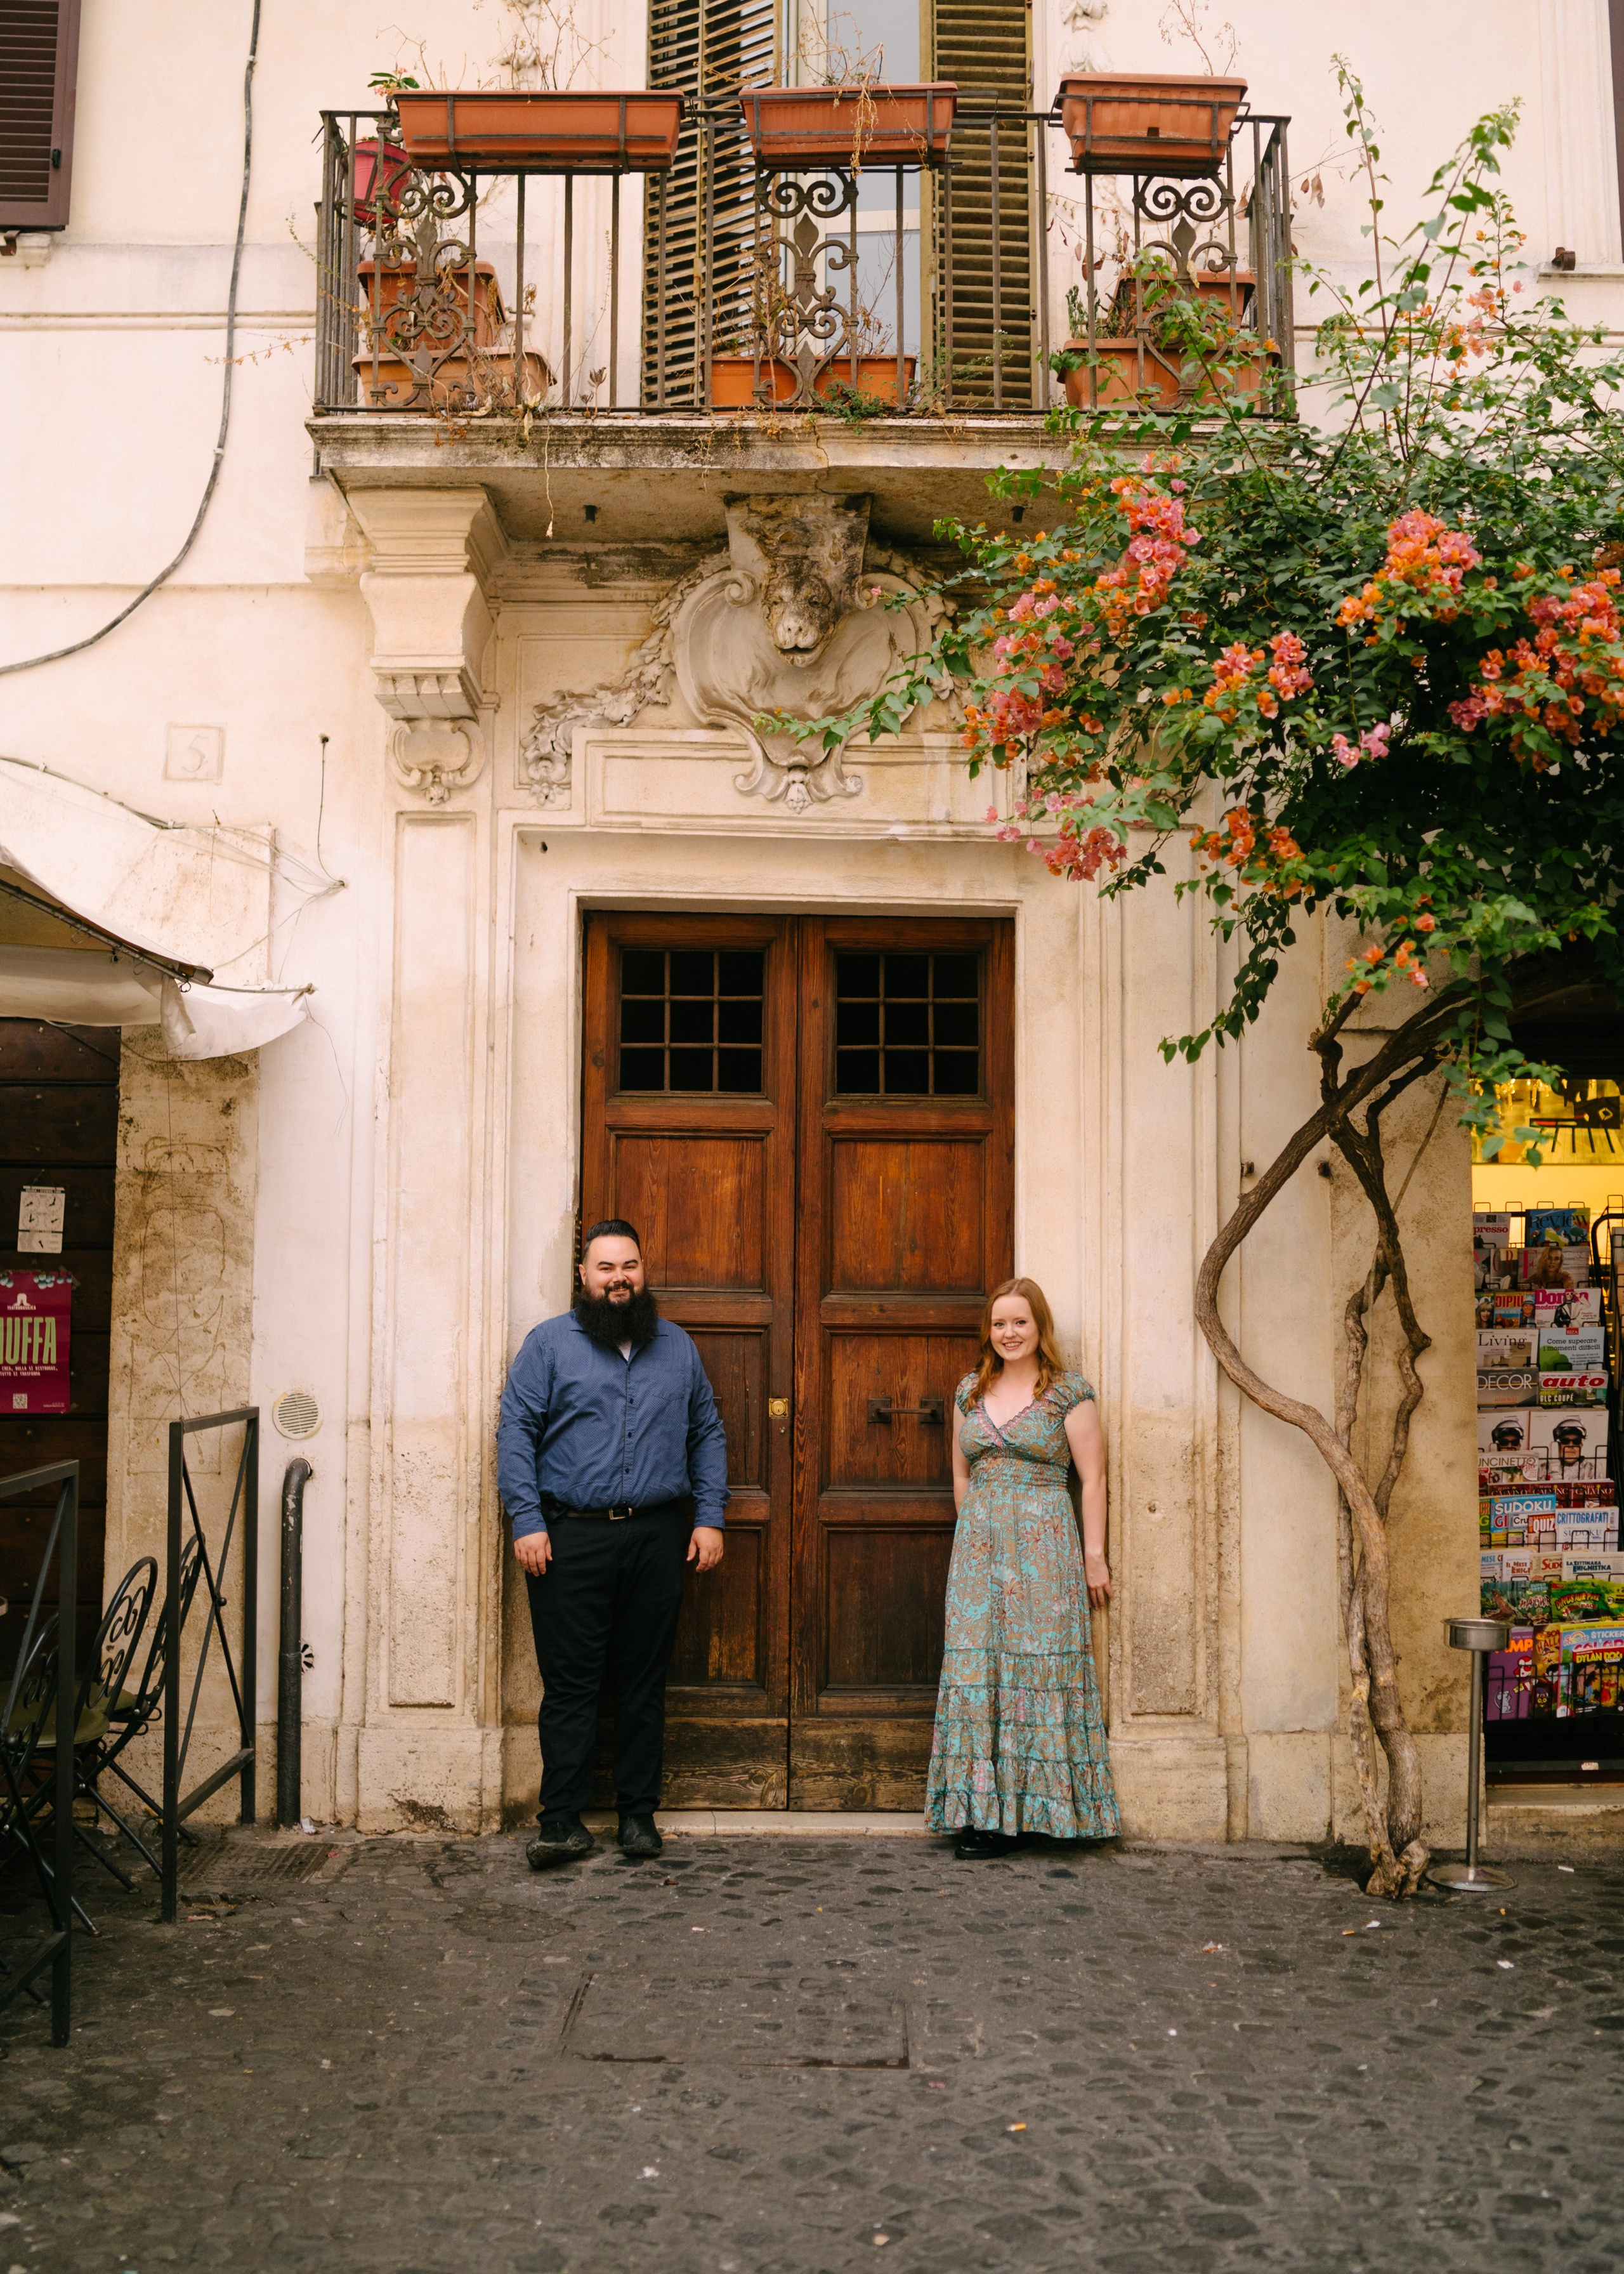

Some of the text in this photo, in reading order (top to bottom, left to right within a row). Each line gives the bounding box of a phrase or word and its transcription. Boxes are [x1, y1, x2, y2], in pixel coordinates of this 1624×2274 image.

[1530, 1213, 1587, 1228] Review
[1479, 1334, 1527, 1350] Living
[1477, 1374, 1532, 1390] DECOR
[1542, 1375, 1605, 1388] auto
[1554, 1393, 1573, 1402] COUPÉ
[1495, 1499, 1552, 1515] SUDOKU
[1533, 1518, 1555, 1532] QUIZ
[1555, 1592, 1587, 1610] DINOSAUR
[1576, 1652, 1623, 1664] DYLAN DOG
